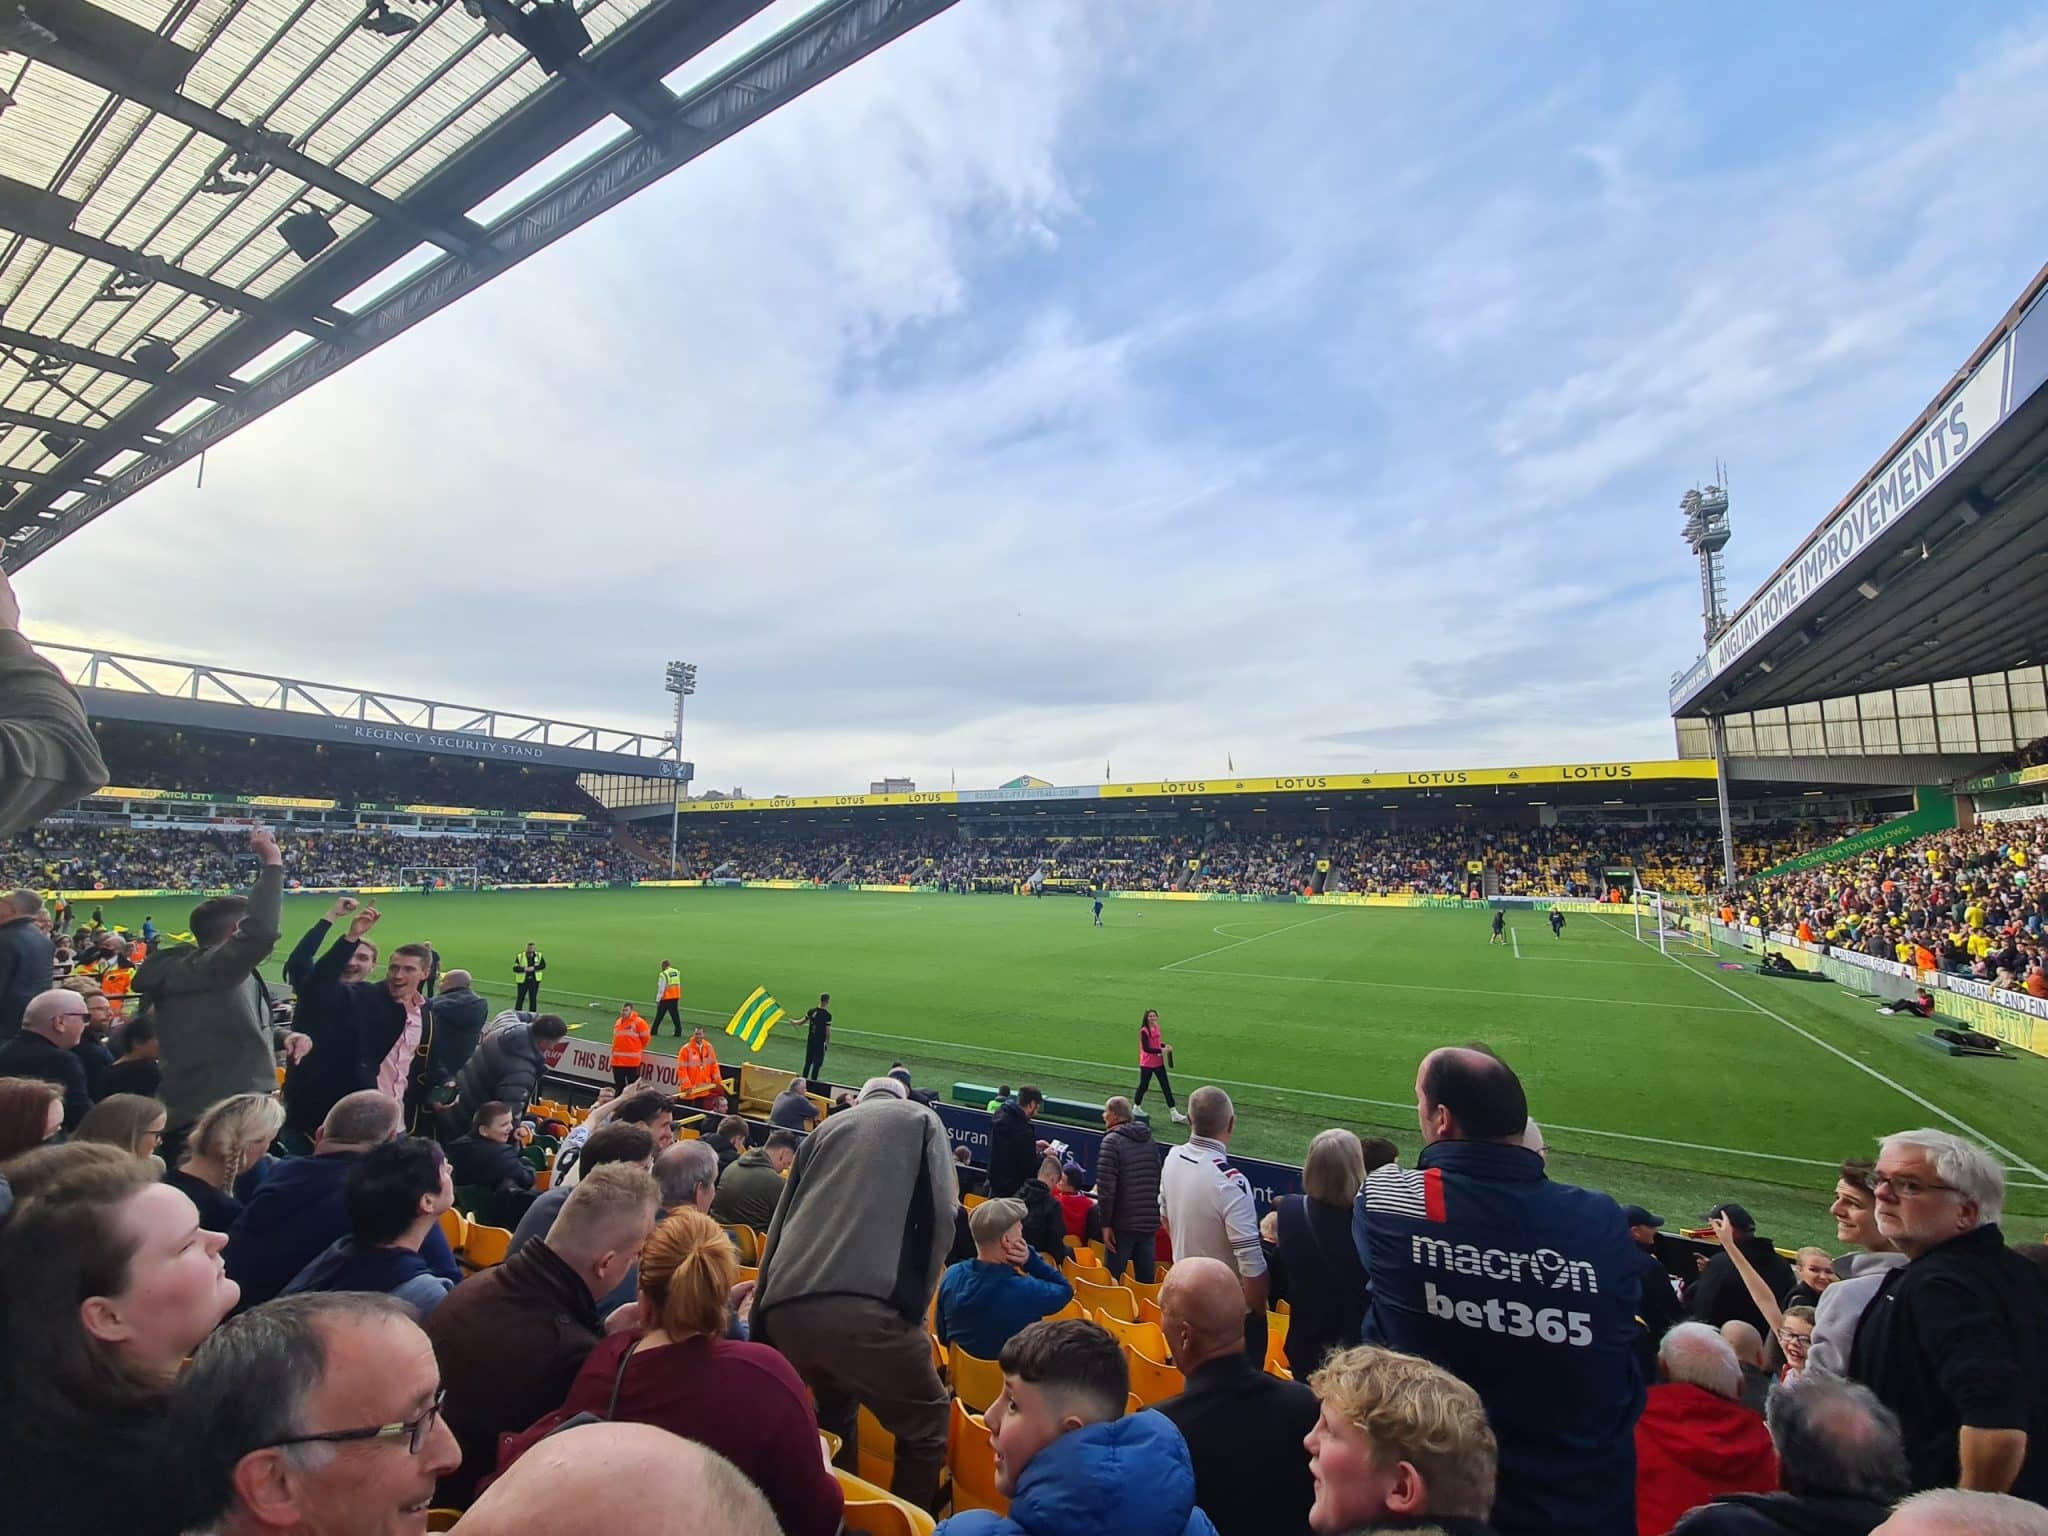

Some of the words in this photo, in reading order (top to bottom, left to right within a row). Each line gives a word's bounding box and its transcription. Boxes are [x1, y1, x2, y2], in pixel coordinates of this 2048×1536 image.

[1718, 614, 1760, 668] ANGLIAN
[1760, 571, 1798, 633] HOME
[1800, 401, 1969, 596] IMPROVEMENTS
[354, 725, 424, 744] REGENCY
[429, 735, 497, 752] SECURITY
[502, 744, 544, 758] STAND
[1408, 772, 1467, 785] LOTUS
[1562, 765, 1632, 779] LOTUS
[1161, 782, 1205, 793] LOTUS
[1275, 777, 1327, 789] LOTUS
[191, 792, 215, 801] CITY
[835, 796, 865, 805] LOTUS
[908, 793, 941, 802] LOTUS
[710, 802, 735, 810] LOTUS
[769, 799, 796, 808] LOTUS
[2004, 993, 2027, 1011] AND
[572, 1049, 598, 1069] THIS
[947, 1127, 988, 1147] suran
[1411, 1234, 1599, 1294] macron
[1424, 1281, 1593, 1347] bet365
